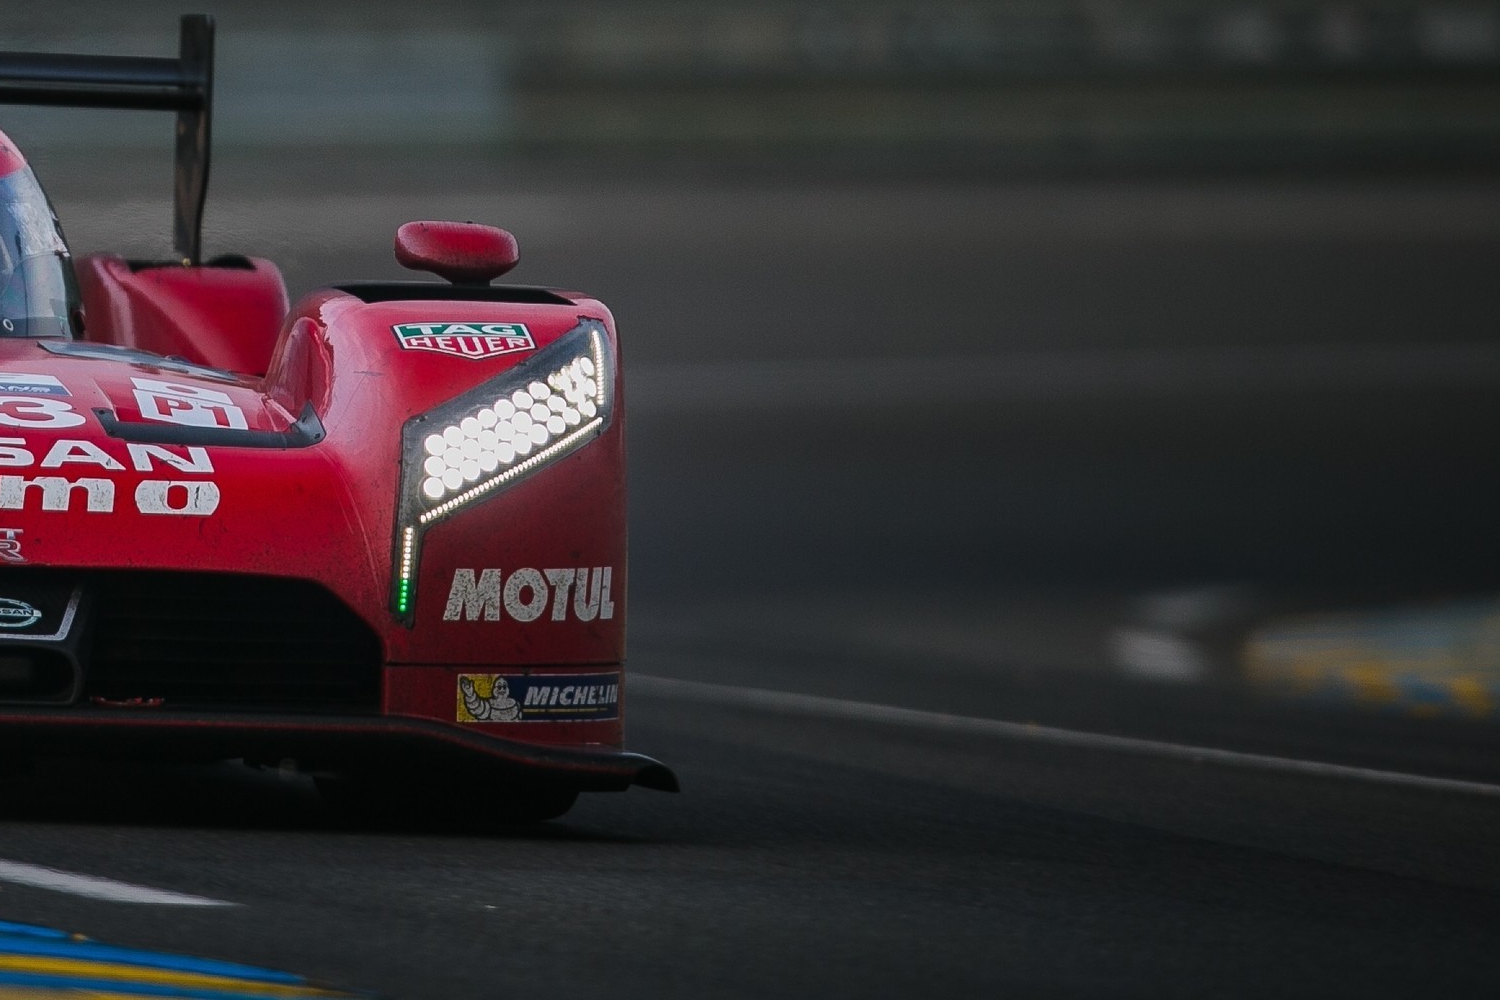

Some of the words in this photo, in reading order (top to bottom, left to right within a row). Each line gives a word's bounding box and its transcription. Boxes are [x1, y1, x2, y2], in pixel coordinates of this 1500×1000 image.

[405, 324, 516, 335] TAG
[410, 336, 527, 356] HEUER
[153, 396, 231, 427] P1
[443, 566, 614, 621] MOTUL
[523, 684, 618, 706] MICHELIN
